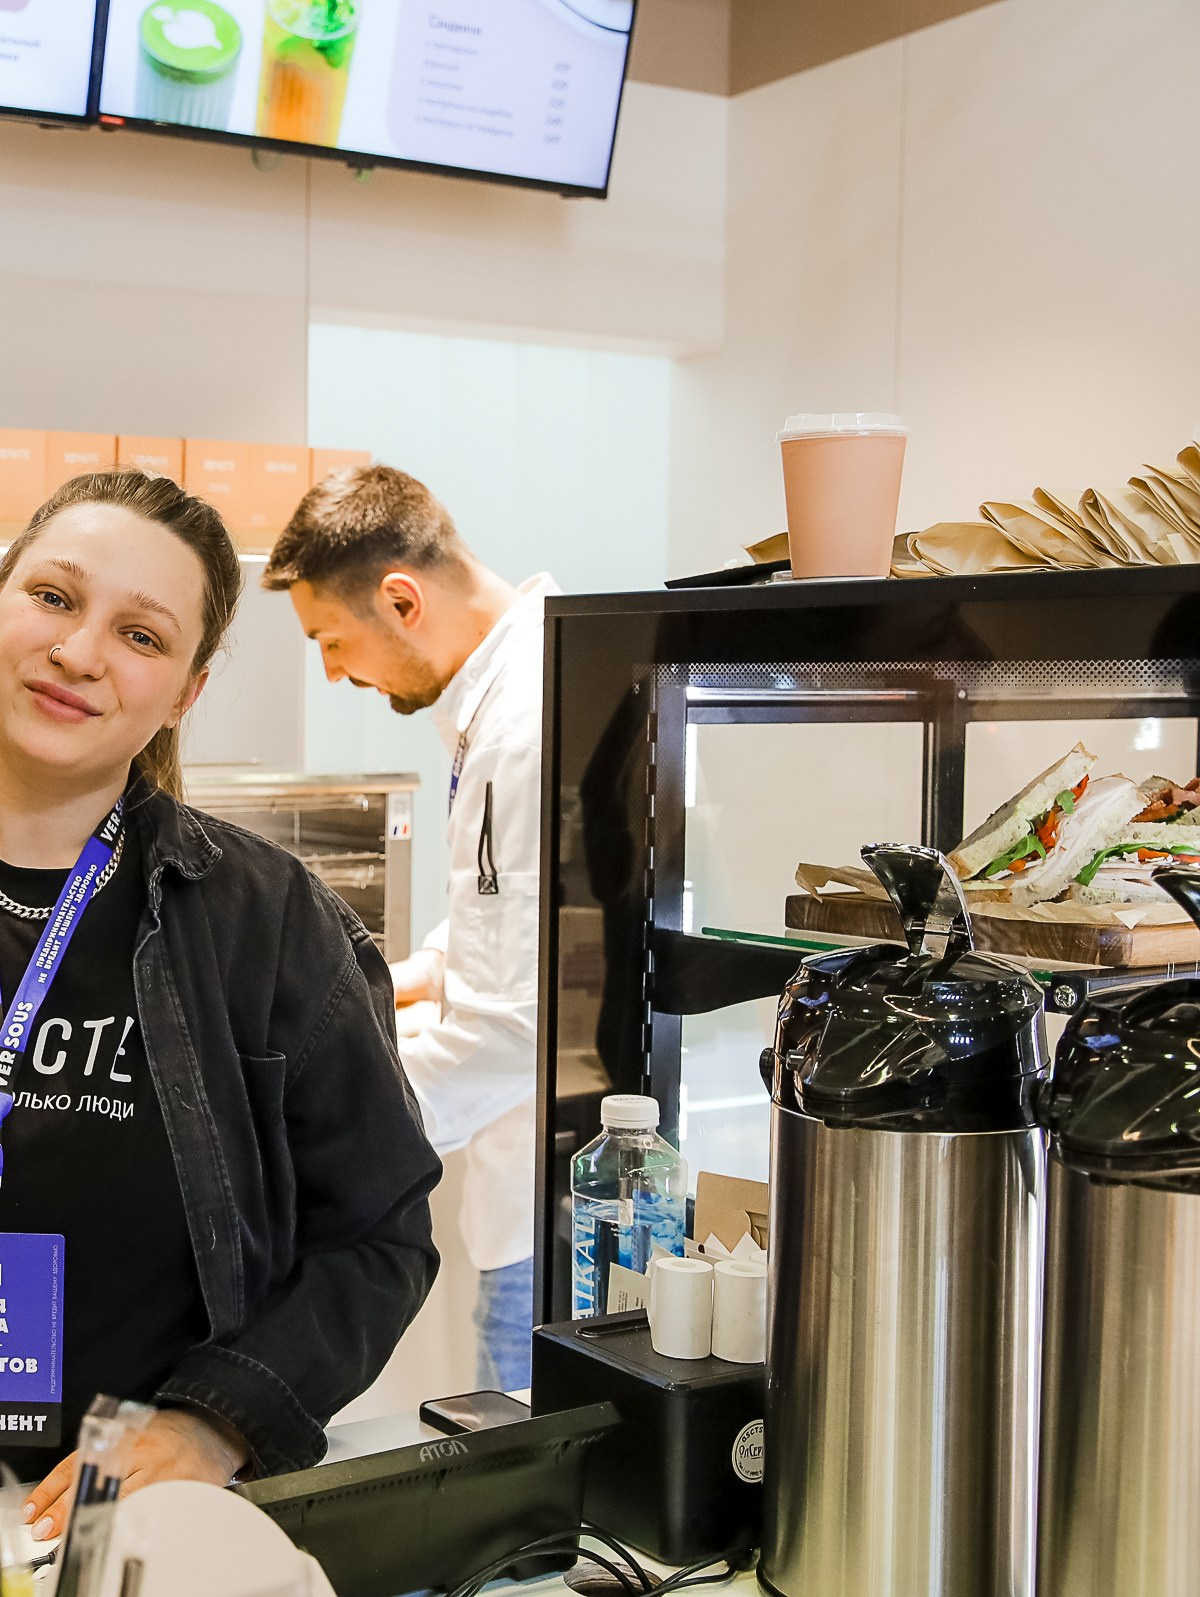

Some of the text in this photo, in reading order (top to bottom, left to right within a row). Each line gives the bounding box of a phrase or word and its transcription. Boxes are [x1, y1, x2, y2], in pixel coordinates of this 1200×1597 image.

[36, 875, 83, 967] ПРЕДПРИНИМАТЕЛЬСТВО
[37, 864, 98, 984] НЕ ВРЕДИТ ВАШЕМУ ЗДОРОВЬЮ
[12, 1090, 72, 1111] ЛЬКО
[75, 1094, 134, 1121] ЛЮДИ
[574, 1216, 595, 1320] IKAL
